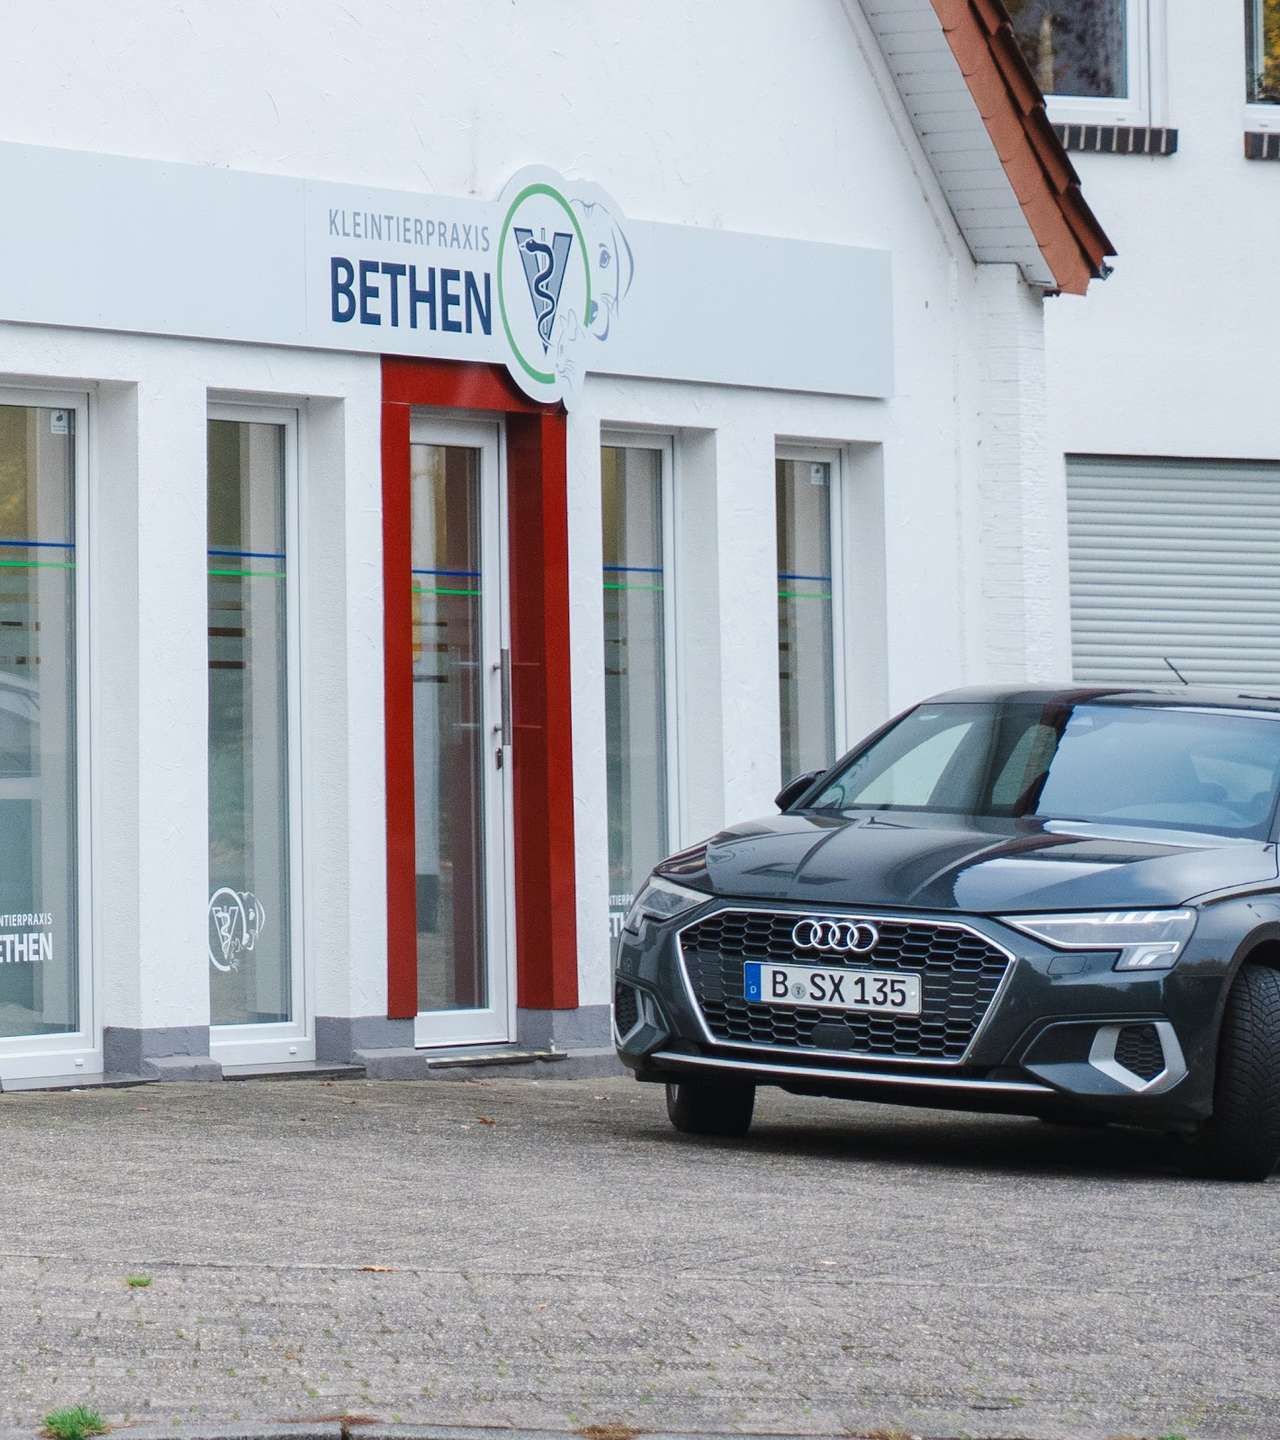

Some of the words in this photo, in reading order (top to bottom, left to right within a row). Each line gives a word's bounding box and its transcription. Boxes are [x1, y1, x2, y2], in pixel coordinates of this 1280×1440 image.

[328, 208, 490, 253] KLEINTIERPRAXIS
[330, 256, 493, 336] BETHEN
[772, 970, 789, 998] B
[810, 973, 845, 1003] SX
[854, 976, 906, 1007] 135
